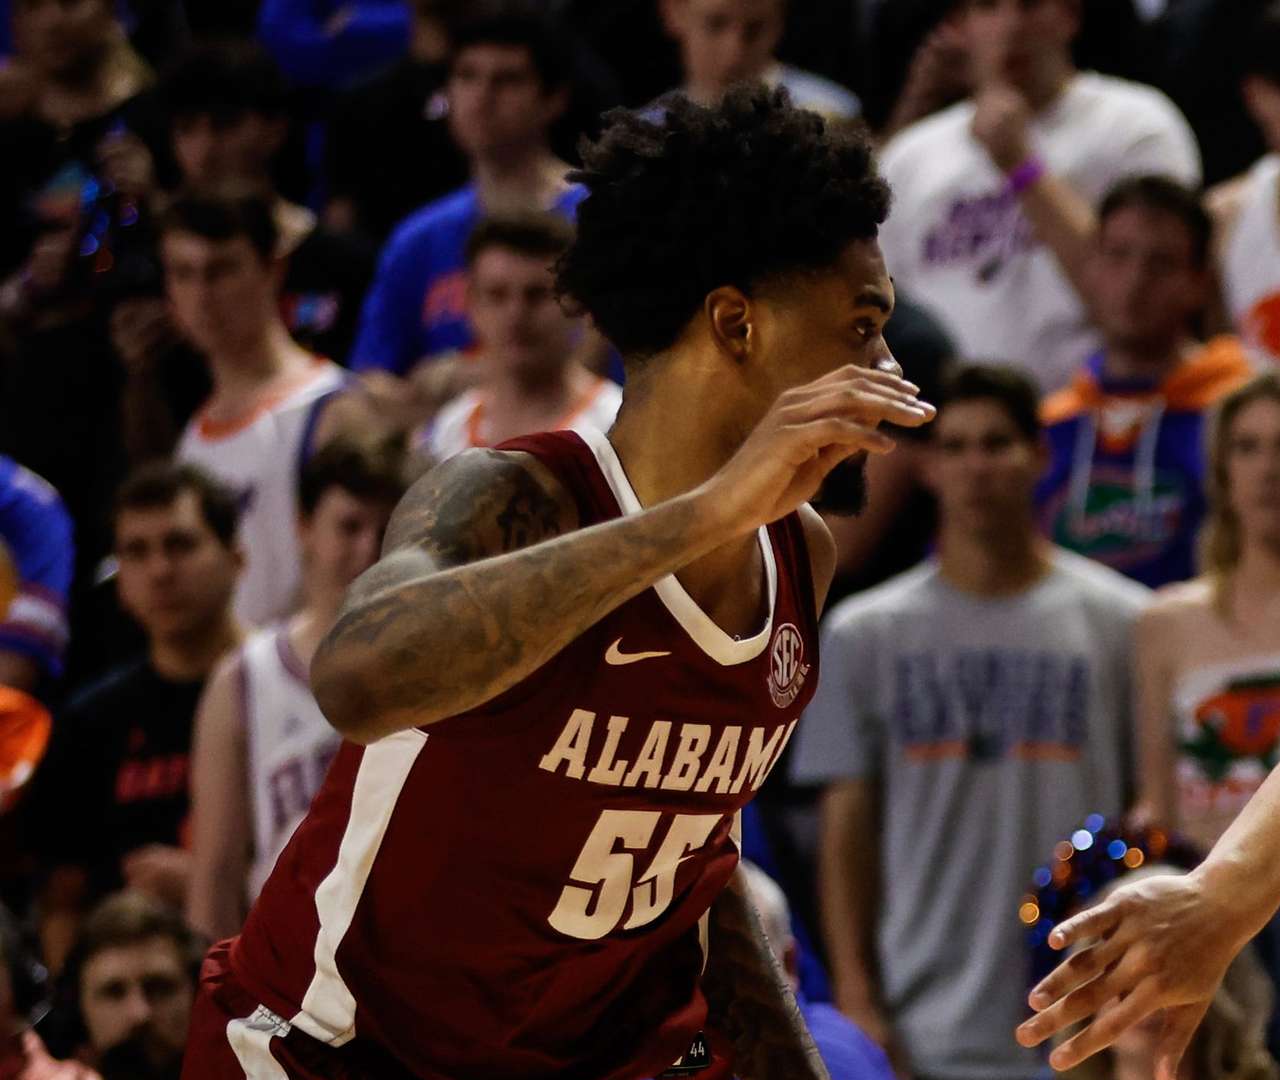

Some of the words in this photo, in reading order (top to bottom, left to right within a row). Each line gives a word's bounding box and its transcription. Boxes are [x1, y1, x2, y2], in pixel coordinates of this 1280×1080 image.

[773, 628, 800, 689] SEC
[546, 808, 725, 941] 55
[689, 1040, 706, 1058] 44
